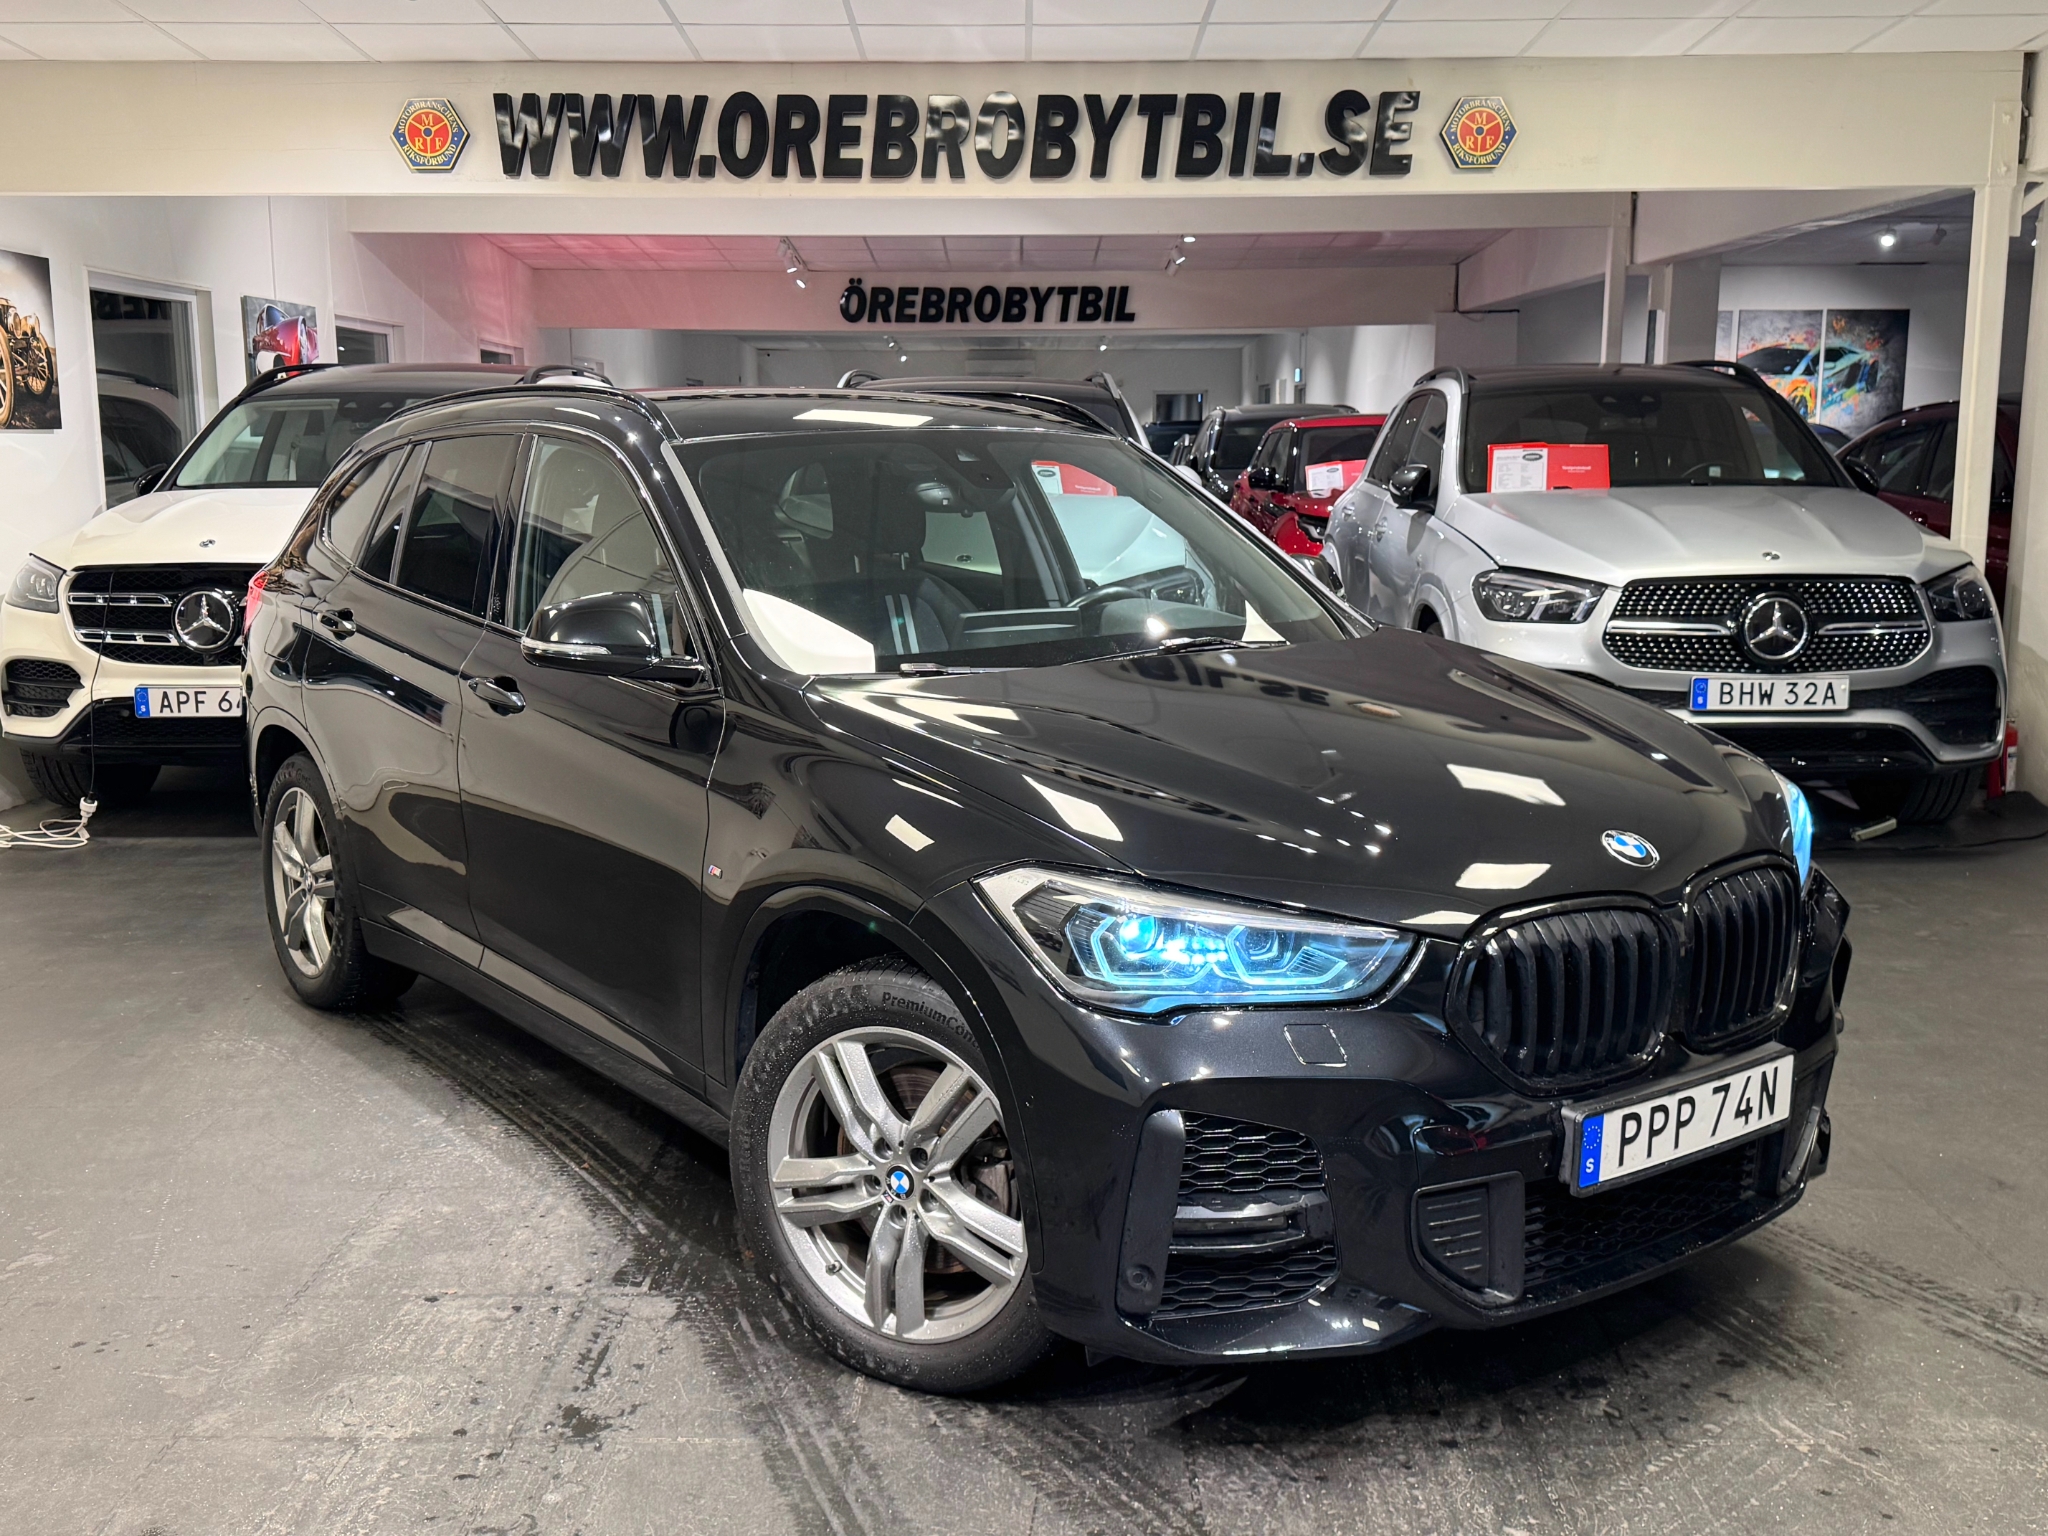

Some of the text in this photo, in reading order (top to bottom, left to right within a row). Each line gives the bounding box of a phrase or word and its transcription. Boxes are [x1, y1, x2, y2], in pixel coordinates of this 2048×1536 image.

[398, 101, 459, 133] MOTORBRANSCHENS
[1450, 99, 1511, 132] MOTORBRANSCHENS
[493, 90, 1421, 179] WWW.OREBROBYTBIL.SE
[839, 277, 1136, 324] ÖREBROBYTBIL
[159, 690, 207, 714] APF
[1719, 682, 1775, 706] BHW
[1784, 682, 1836, 706] 32A
[1585, 1065, 1779, 1174] S PPP 74N
